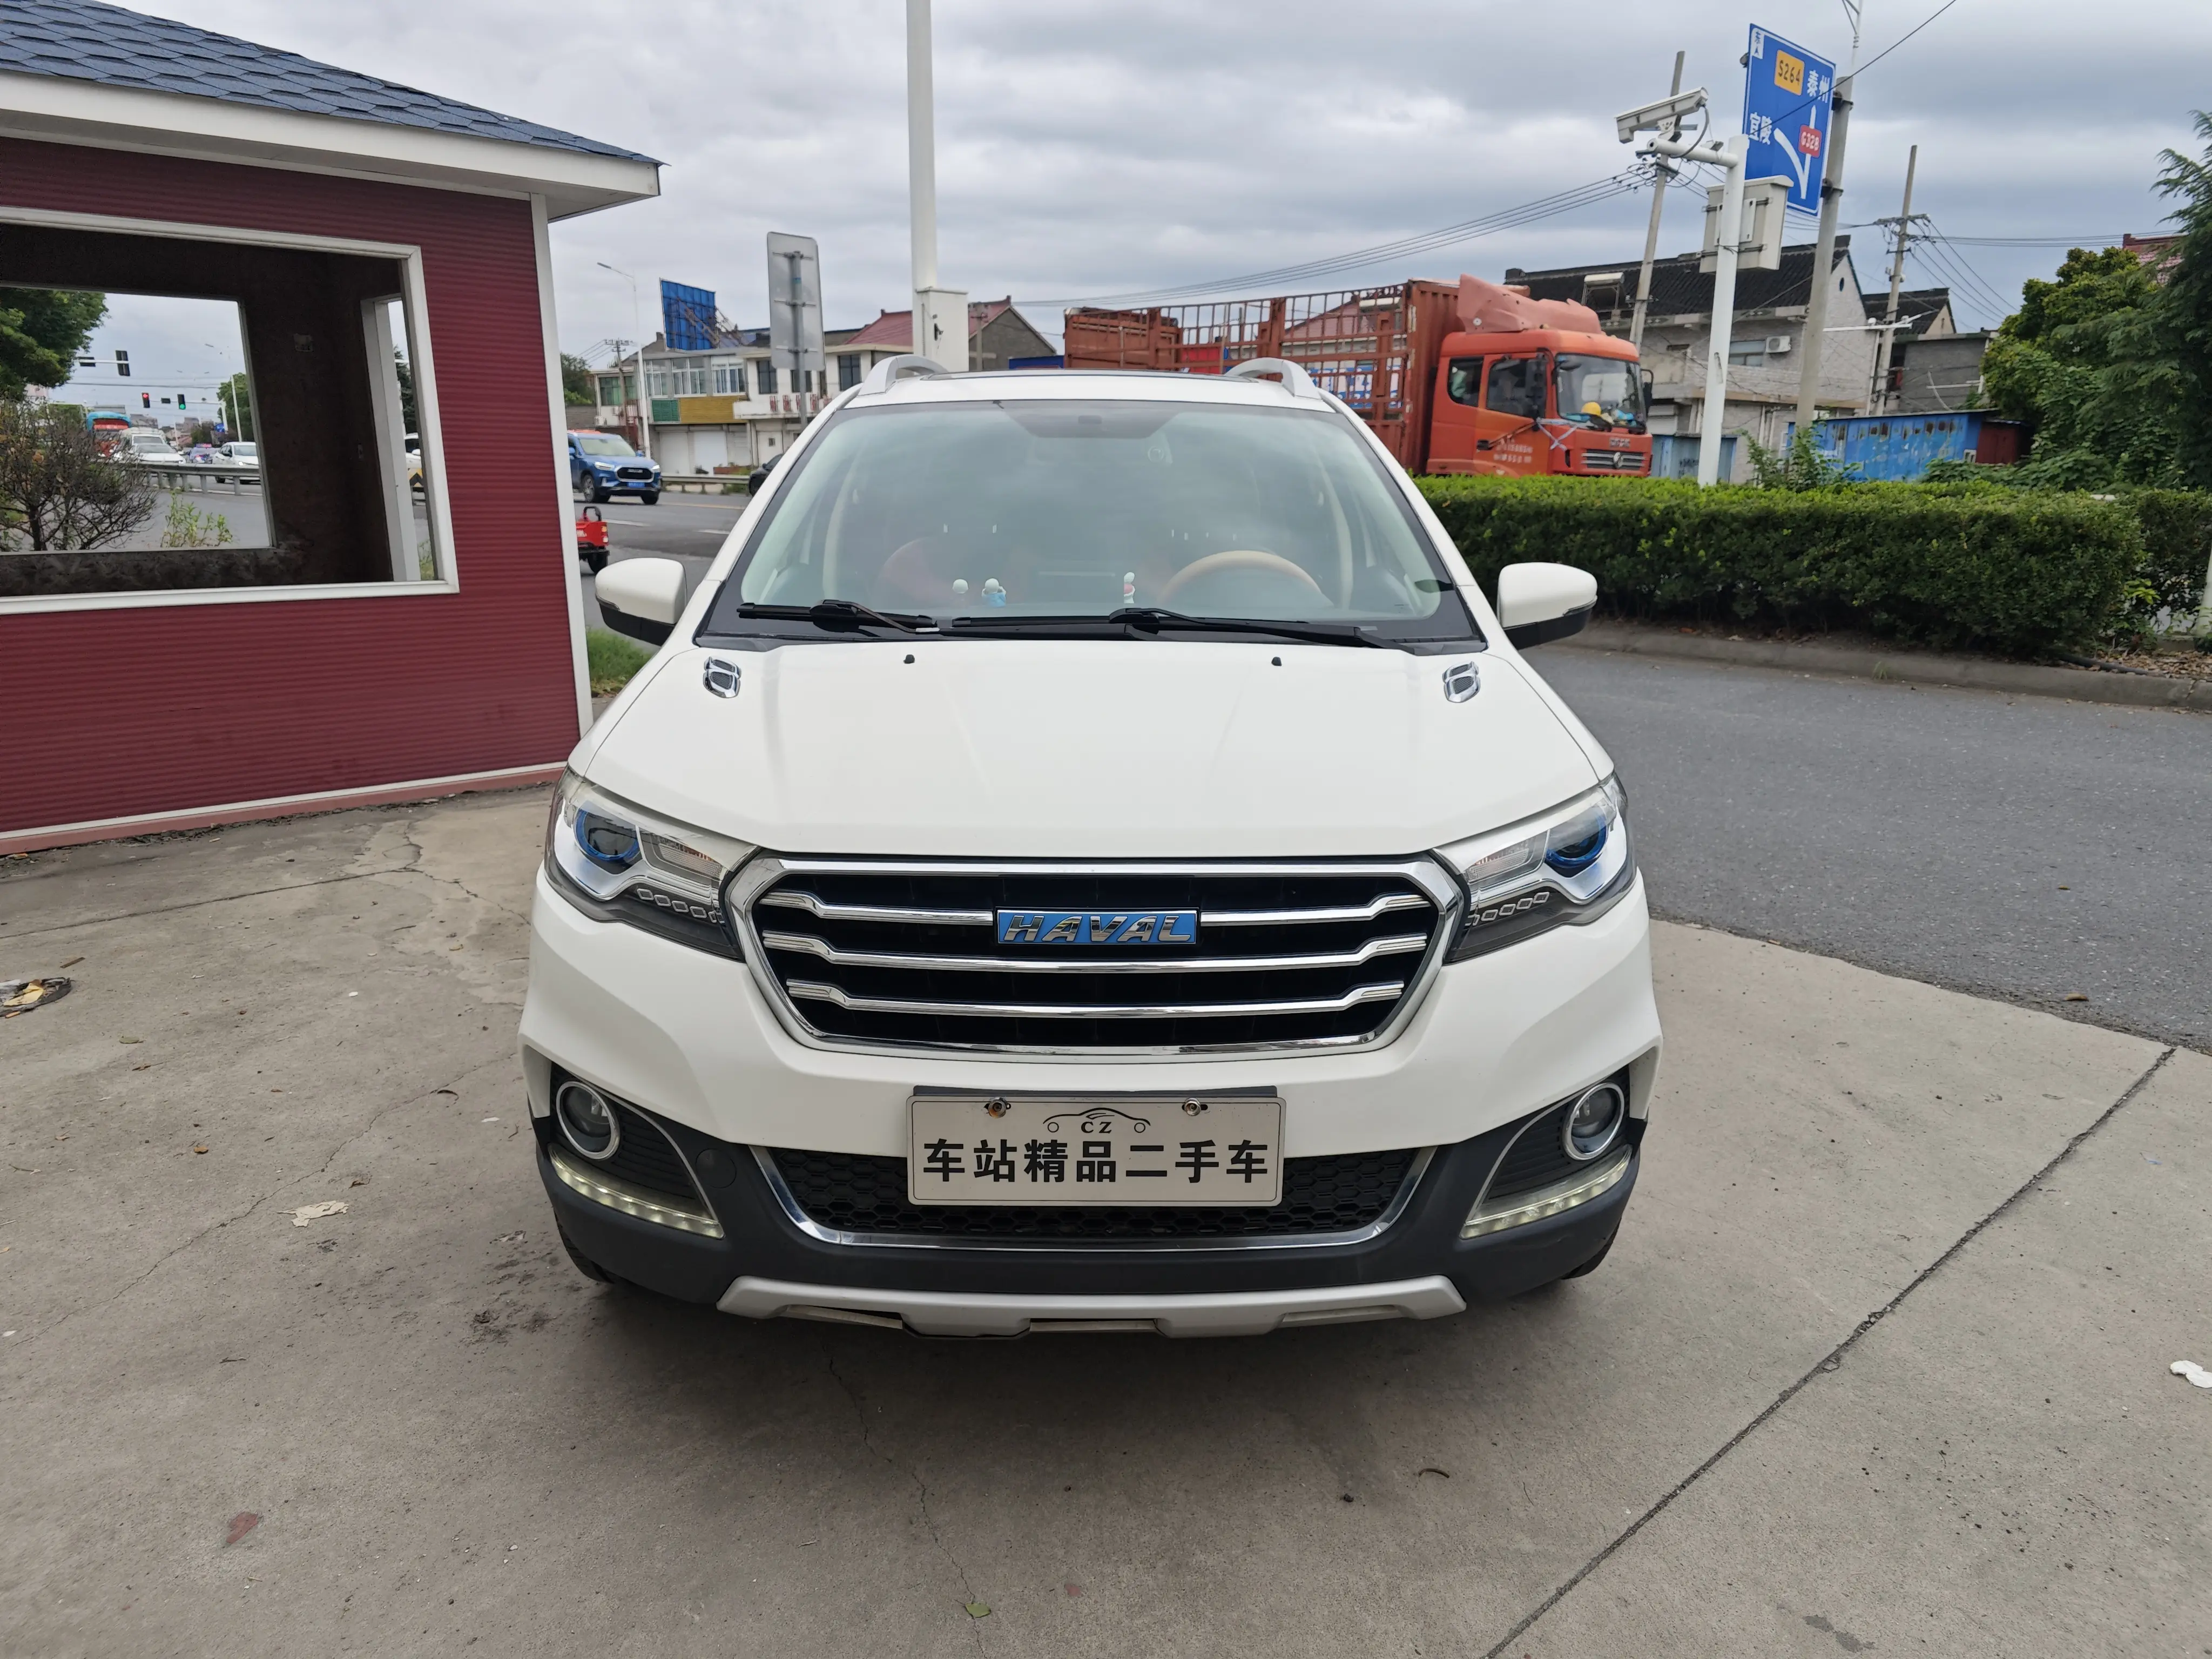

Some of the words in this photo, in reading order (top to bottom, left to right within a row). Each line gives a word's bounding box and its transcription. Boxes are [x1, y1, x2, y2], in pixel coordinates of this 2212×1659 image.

[1778, 59, 1801, 85] S264
[1801, 132, 1819, 151] G328
[1003, 915, 1191, 942] HAVAL
[923, 1138, 1268, 1183] 车站精品二手车
